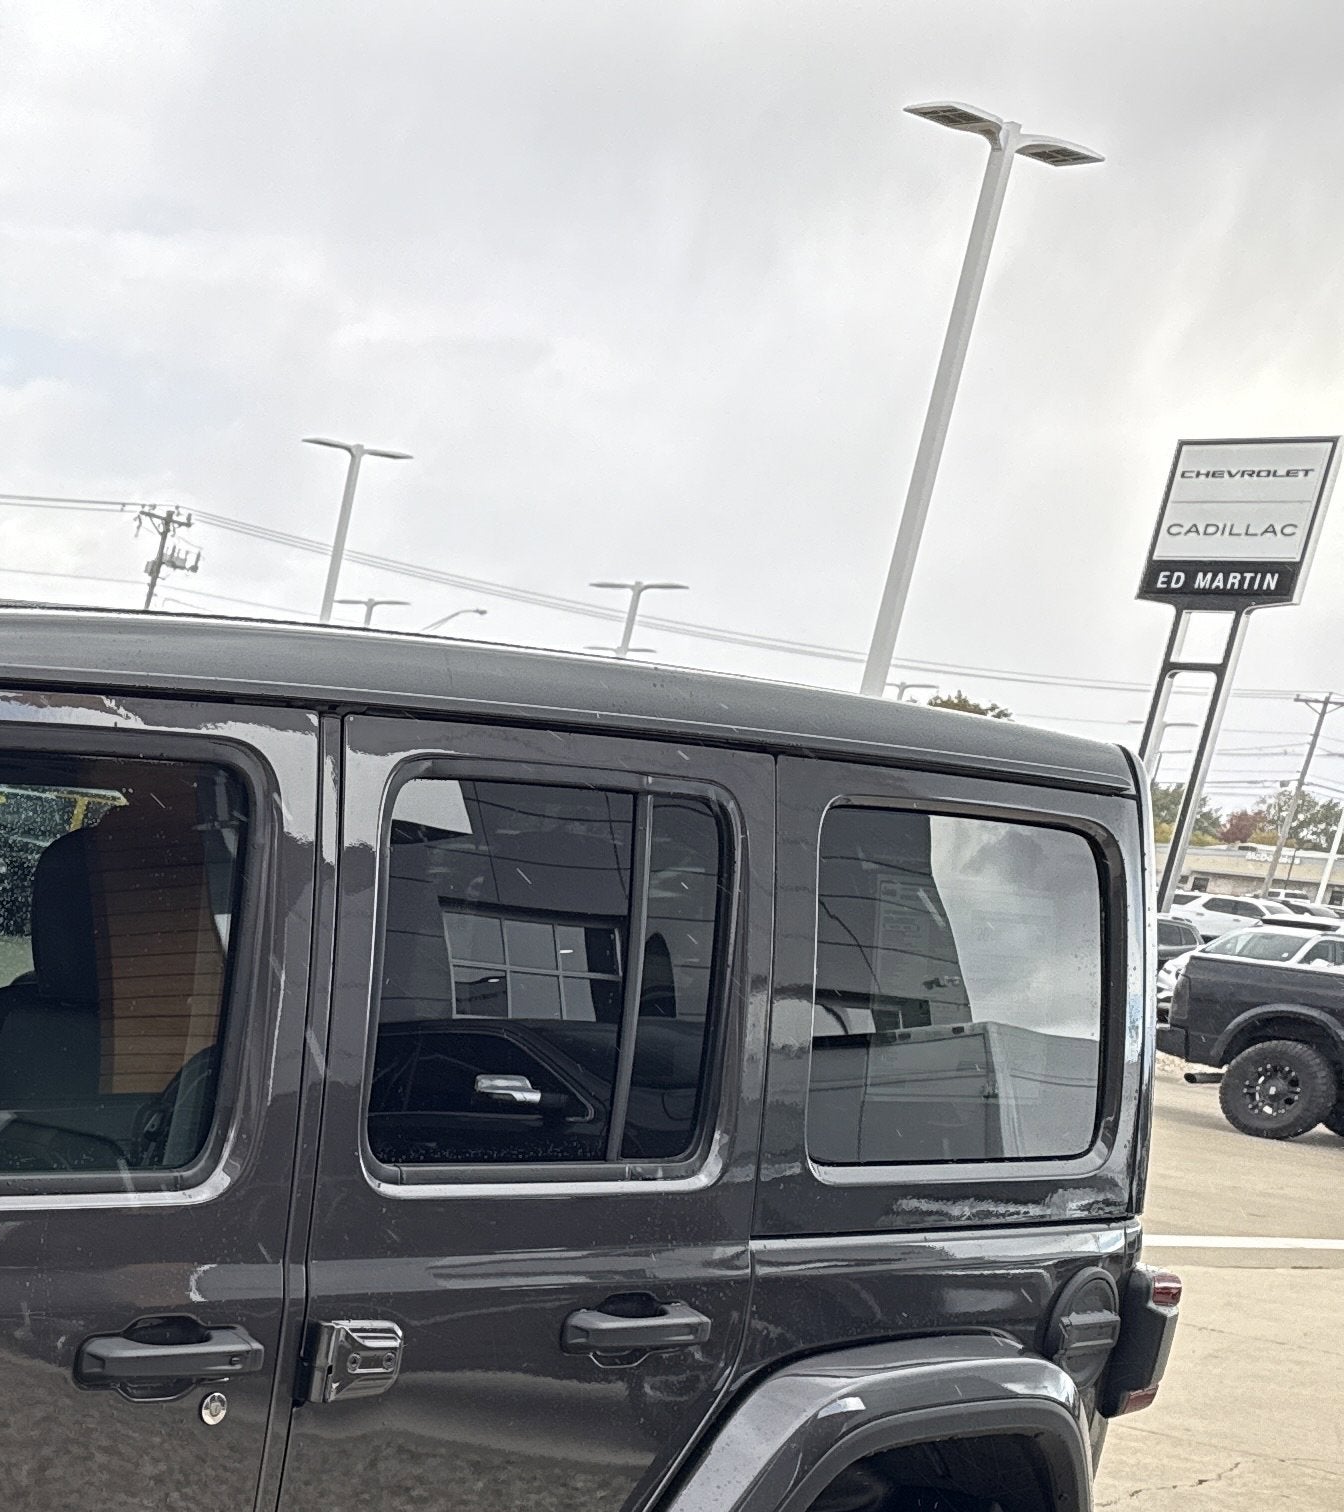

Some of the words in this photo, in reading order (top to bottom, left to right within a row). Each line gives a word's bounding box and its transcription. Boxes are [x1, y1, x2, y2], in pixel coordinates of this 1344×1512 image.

[1180, 468, 1315, 480] CHEVROLET
[1166, 523, 1299, 537] CADILLAC
[1156, 571, 1185, 589] ED
[1194, 572, 1280, 591] MARTIN
